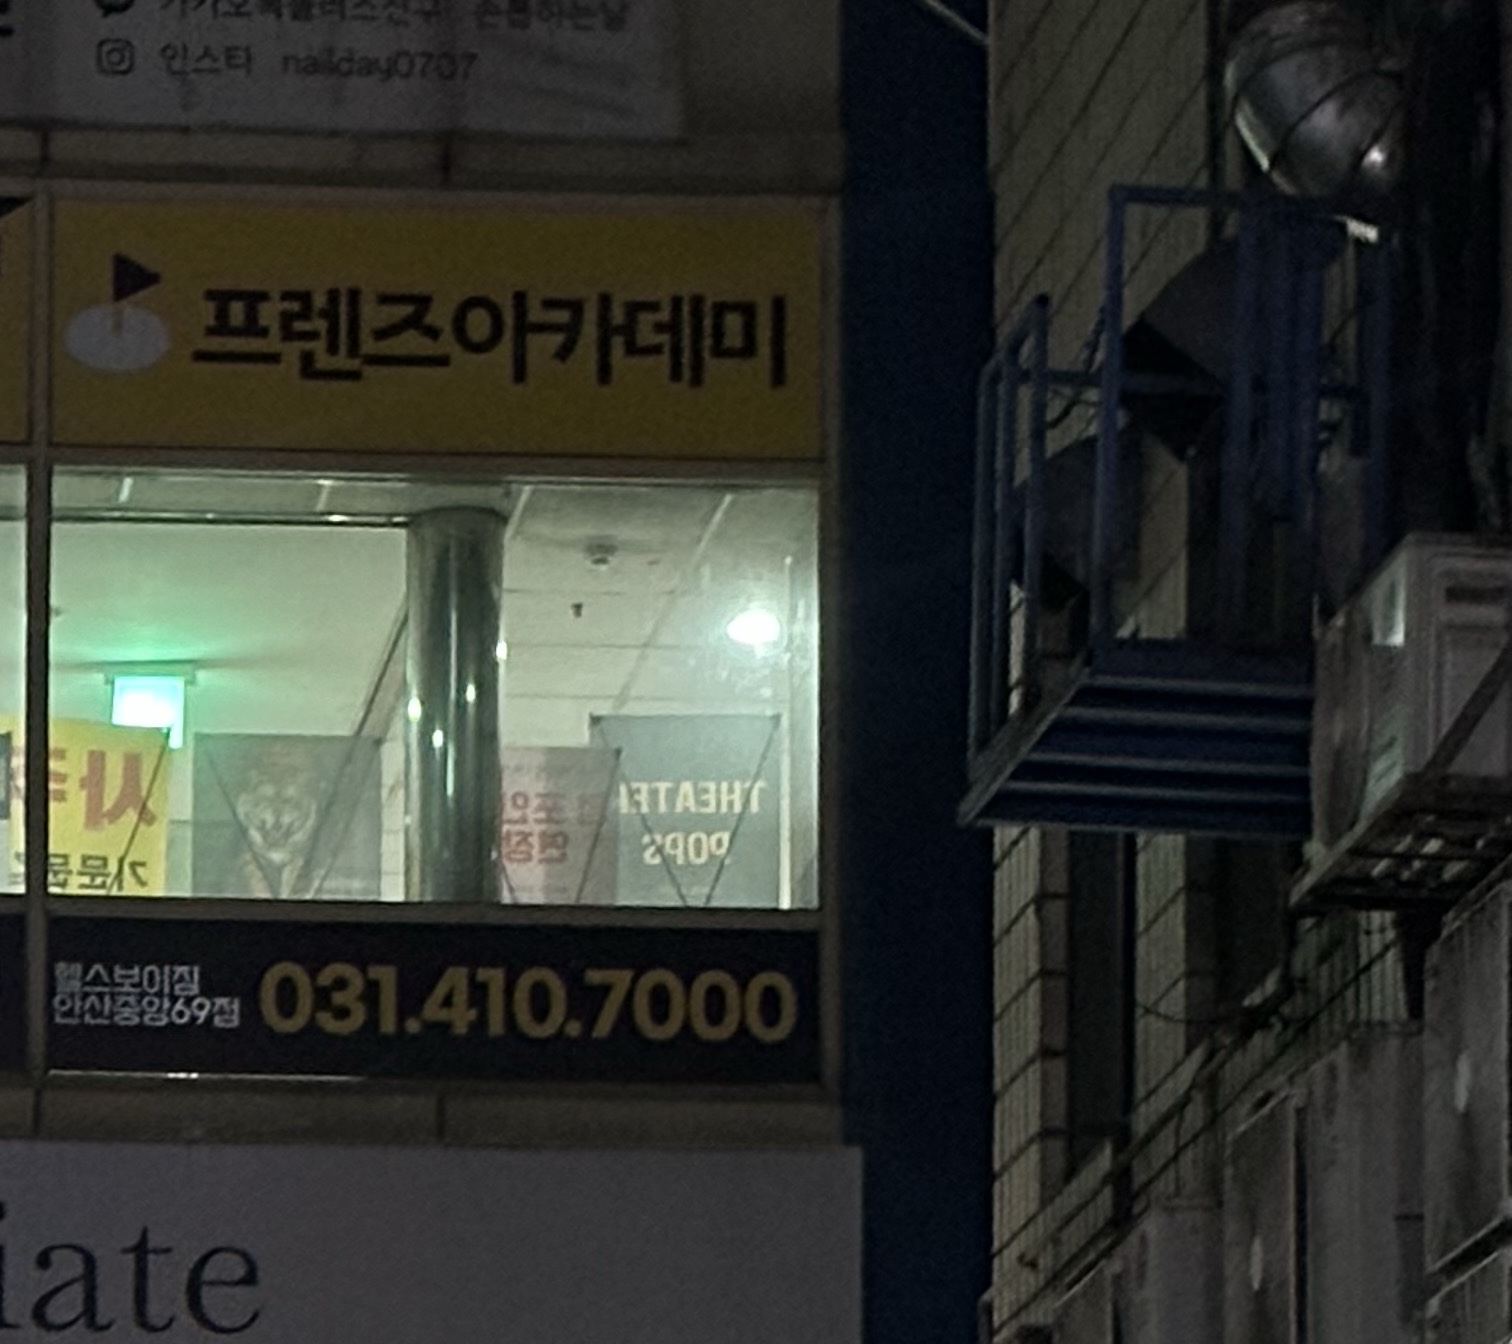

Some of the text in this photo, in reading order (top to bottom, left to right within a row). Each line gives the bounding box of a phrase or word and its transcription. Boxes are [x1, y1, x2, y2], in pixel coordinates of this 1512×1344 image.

[159, 43, 252, 76] 인스타
[191, 287, 789, 389] 프렌즈아카데미
[53, 952, 200, 996] 헬스보이짐
[258, 961, 798, 1043] 031.410.7000
